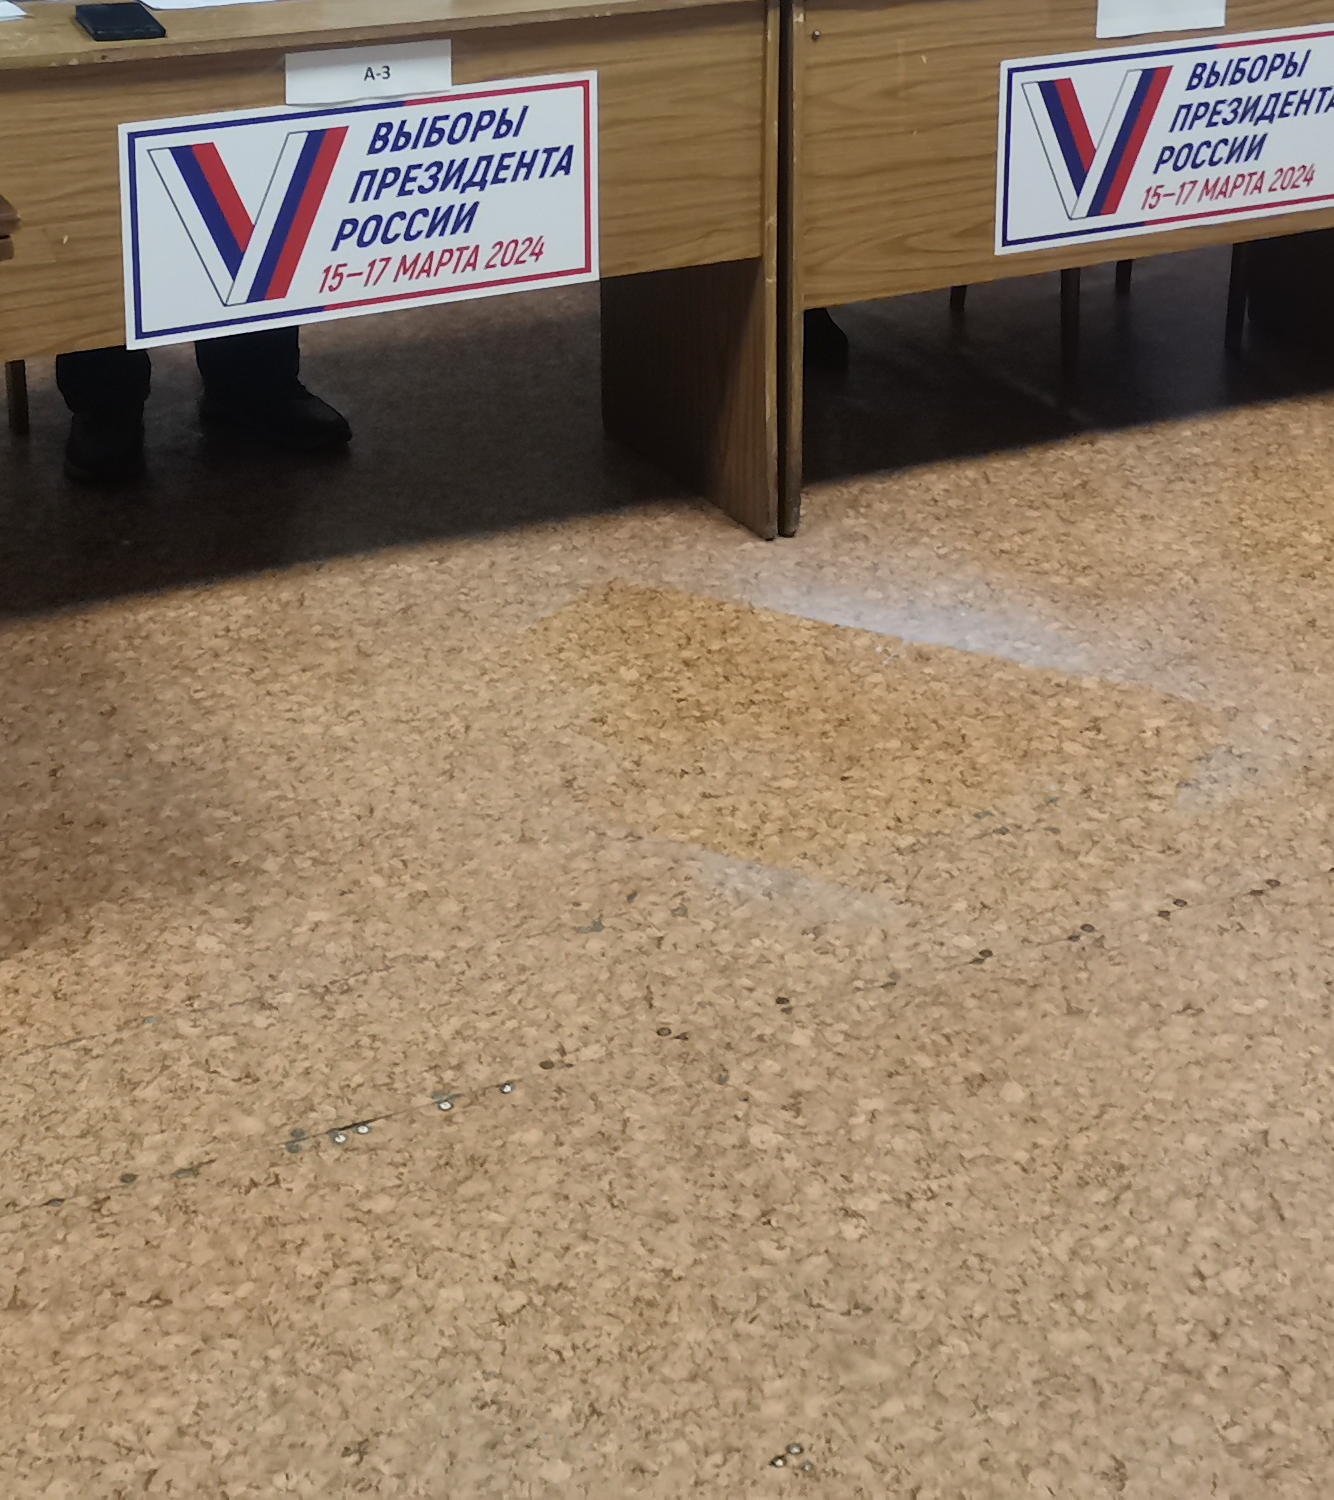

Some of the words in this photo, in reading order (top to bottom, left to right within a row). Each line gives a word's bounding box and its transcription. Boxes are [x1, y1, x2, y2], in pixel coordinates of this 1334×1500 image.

[1185, 49, 1312, 91] ВЫБОРЫ
[367, 105, 529, 155] ВЫБОРЫ
[1152, 133, 1268, 174] РОССИИ
[349, 145, 575, 204] ПРЕЗИДЕНТА
[1197, 171, 1264, 203] МАРТА
[1267, 163, 1316, 193] 2024
[332, 202, 480, 251] РОССИИ
[394, 247, 479, 283] МАРТА
[484, 235, 545, 269] 2024
